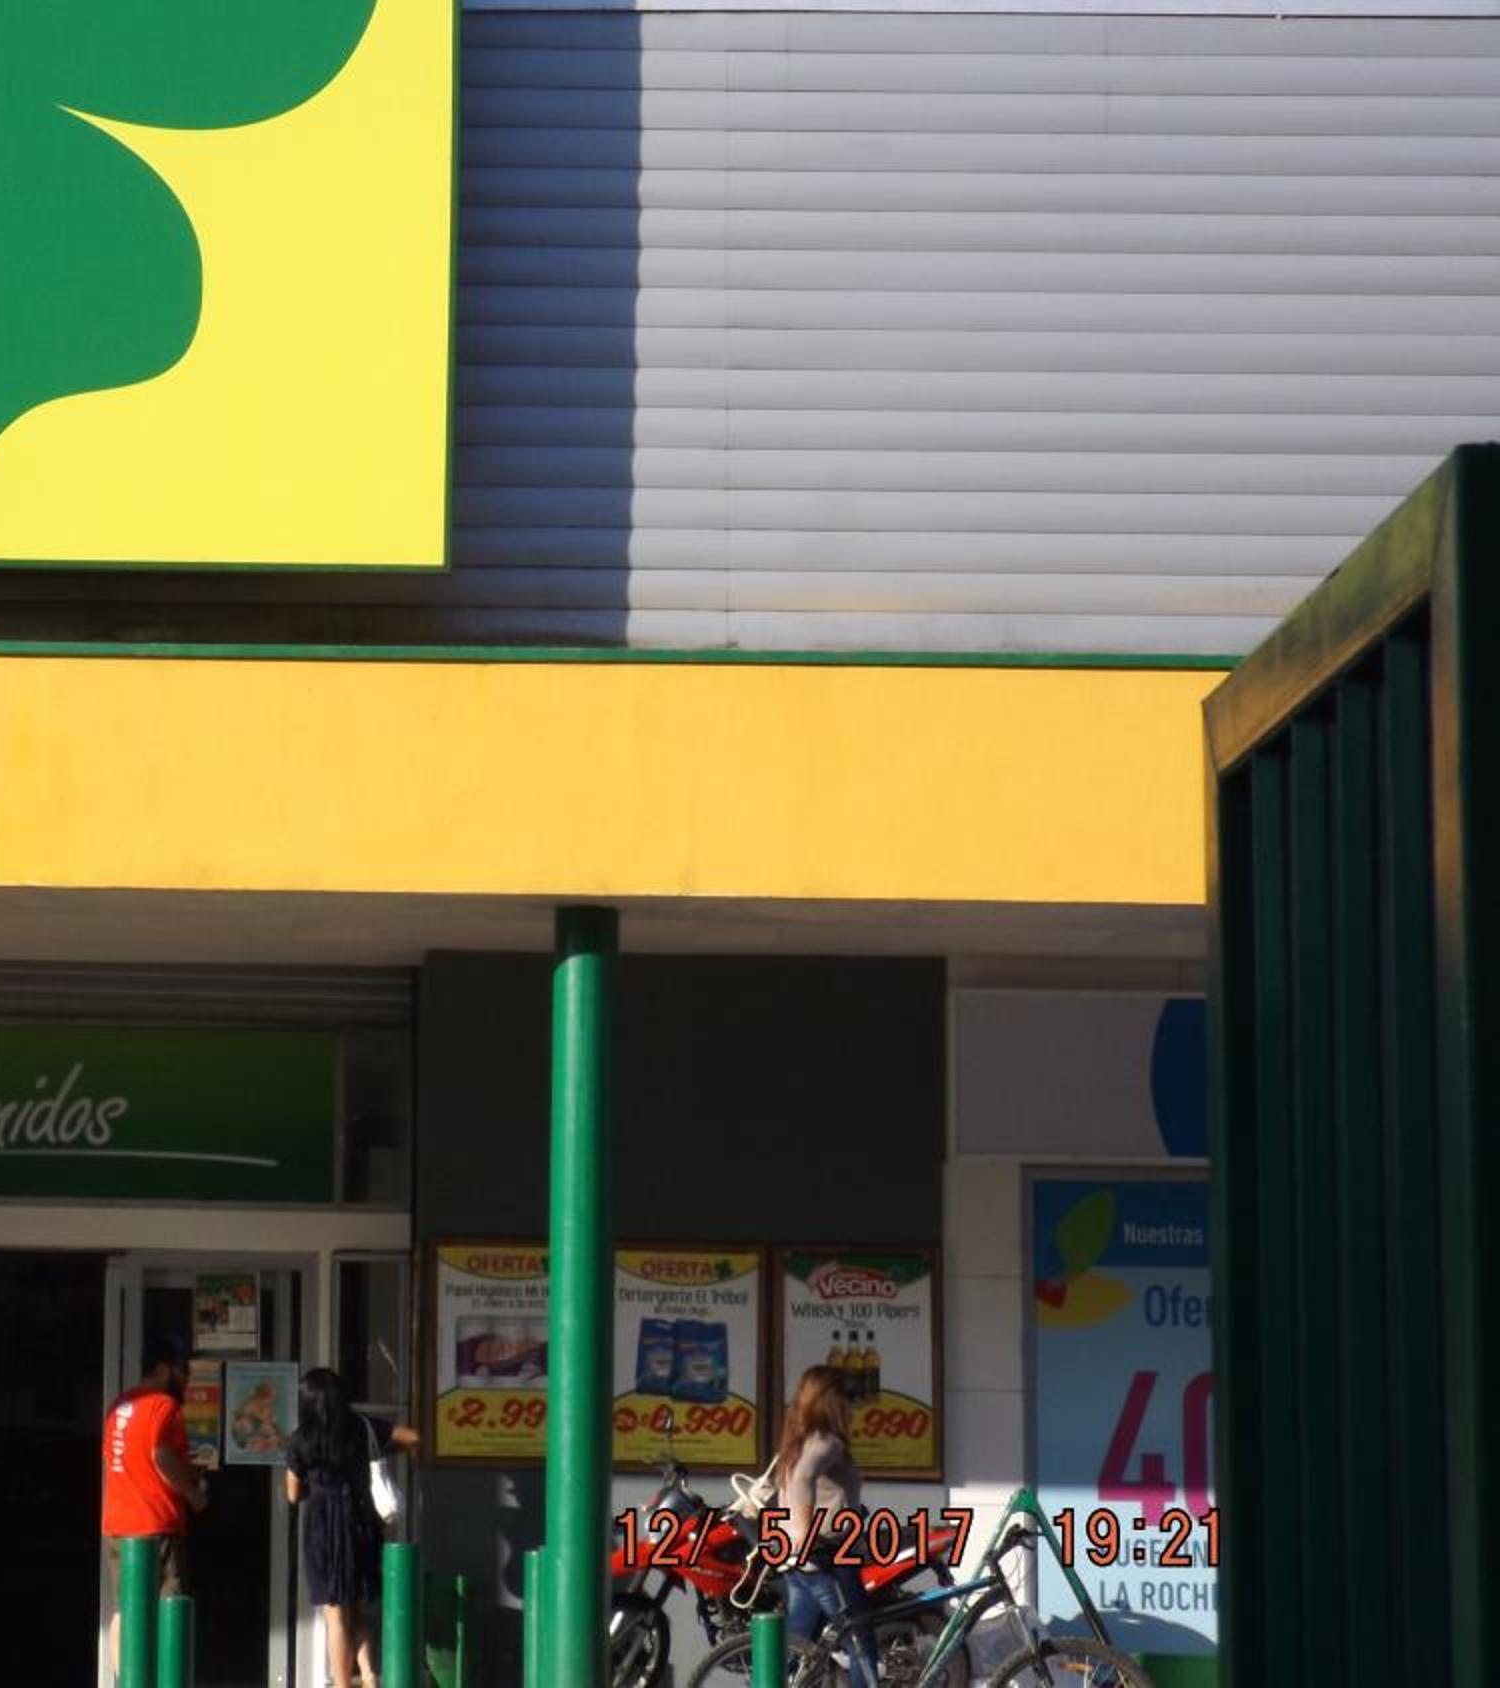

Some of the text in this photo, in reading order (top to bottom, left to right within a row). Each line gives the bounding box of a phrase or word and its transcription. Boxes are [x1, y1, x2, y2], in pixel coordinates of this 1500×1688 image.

[1124, 1223, 1204, 1245] Nuestras
[467, 1255, 538, 1273] OFERTA
[641, 1260, 711, 1279] OFERTA
[819, 1275, 897, 1297] Vecino
[448, 1398, 548, 1428] $2.99
[1100, 1581, 1130, 1610] LA
